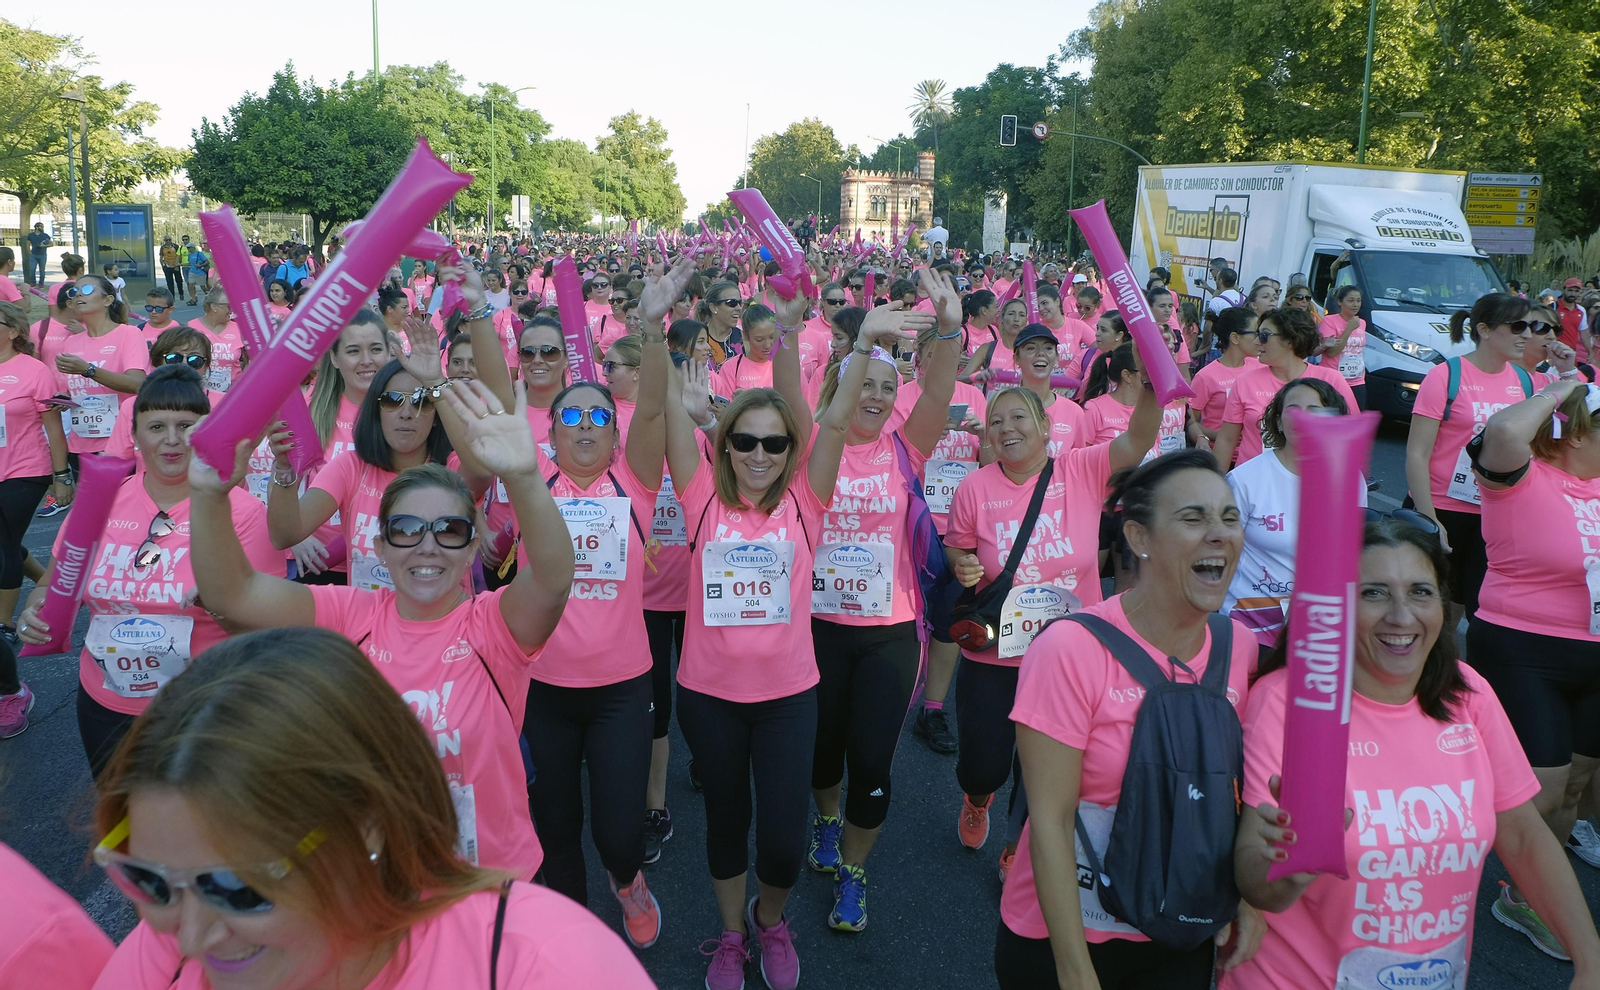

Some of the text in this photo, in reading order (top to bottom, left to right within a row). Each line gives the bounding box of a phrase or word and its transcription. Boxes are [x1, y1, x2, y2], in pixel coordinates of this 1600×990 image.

[1144, 176, 1284, 191] ALQUILER DE CAMIONES SIN CONDUCTOR
[1165, 205, 1241, 241] Demetrio
[1370, 207, 1394, 223] ALQUILER
[1407, 207, 1459, 229] FURGONETAS
[1401, 218, 1444, 228] CONDUCTOR
[1376, 226, 1464, 242] Demetrio
[1107, 269, 1146, 325] Ladival
[284, 270, 369, 362] Ladival
[82, 414, 103, 424] 016
[1163, 407, 1183, 428] OY
[932, 446, 973, 461] ANAN
[941, 486, 955, 495] 01
[982, 499, 1013, 510] OYSHO
[107, 518, 139, 531] YSHO
[823, 512, 861, 530] LAS
[573, 534, 600, 550] 16
[822, 532, 892, 545] CHICAS
[94, 543, 189, 582] HOY
[575, 553, 587, 561] 03
[728, 553, 774, 563] ASTURIANA
[832, 553, 871, 563] ASTURIANA
[51, 540, 88, 597] Ladival
[1014, 566, 1042, 584] AS
[1062, 567, 1077, 576] 2017
[87, 578, 184, 604] GANAN
[732, 581, 772, 597] 016
[833, 577, 868, 593] 016
[89, 600, 140, 616] LAS
[745, 599, 760, 607] 504
[1017, 596, 1059, 605] ASTURIANA
[113, 627, 162, 639] ASTURIANA
[1003, 644, 1025, 653] OYSHO
[1294, 592, 1344, 711] Ladival
[117, 656, 161, 671] 016
[132, 673, 149, 681] 534
[401, 680, 454, 731] OY
[1353, 778, 1477, 846] HOY
[1358, 840, 1488, 880] GANAN
[1355, 880, 1424, 912] LAS
[1451, 892, 1472, 905] 2017
[1083, 907, 1108, 922] SHO
[1352, 904, 1469, 945] CHICAS
